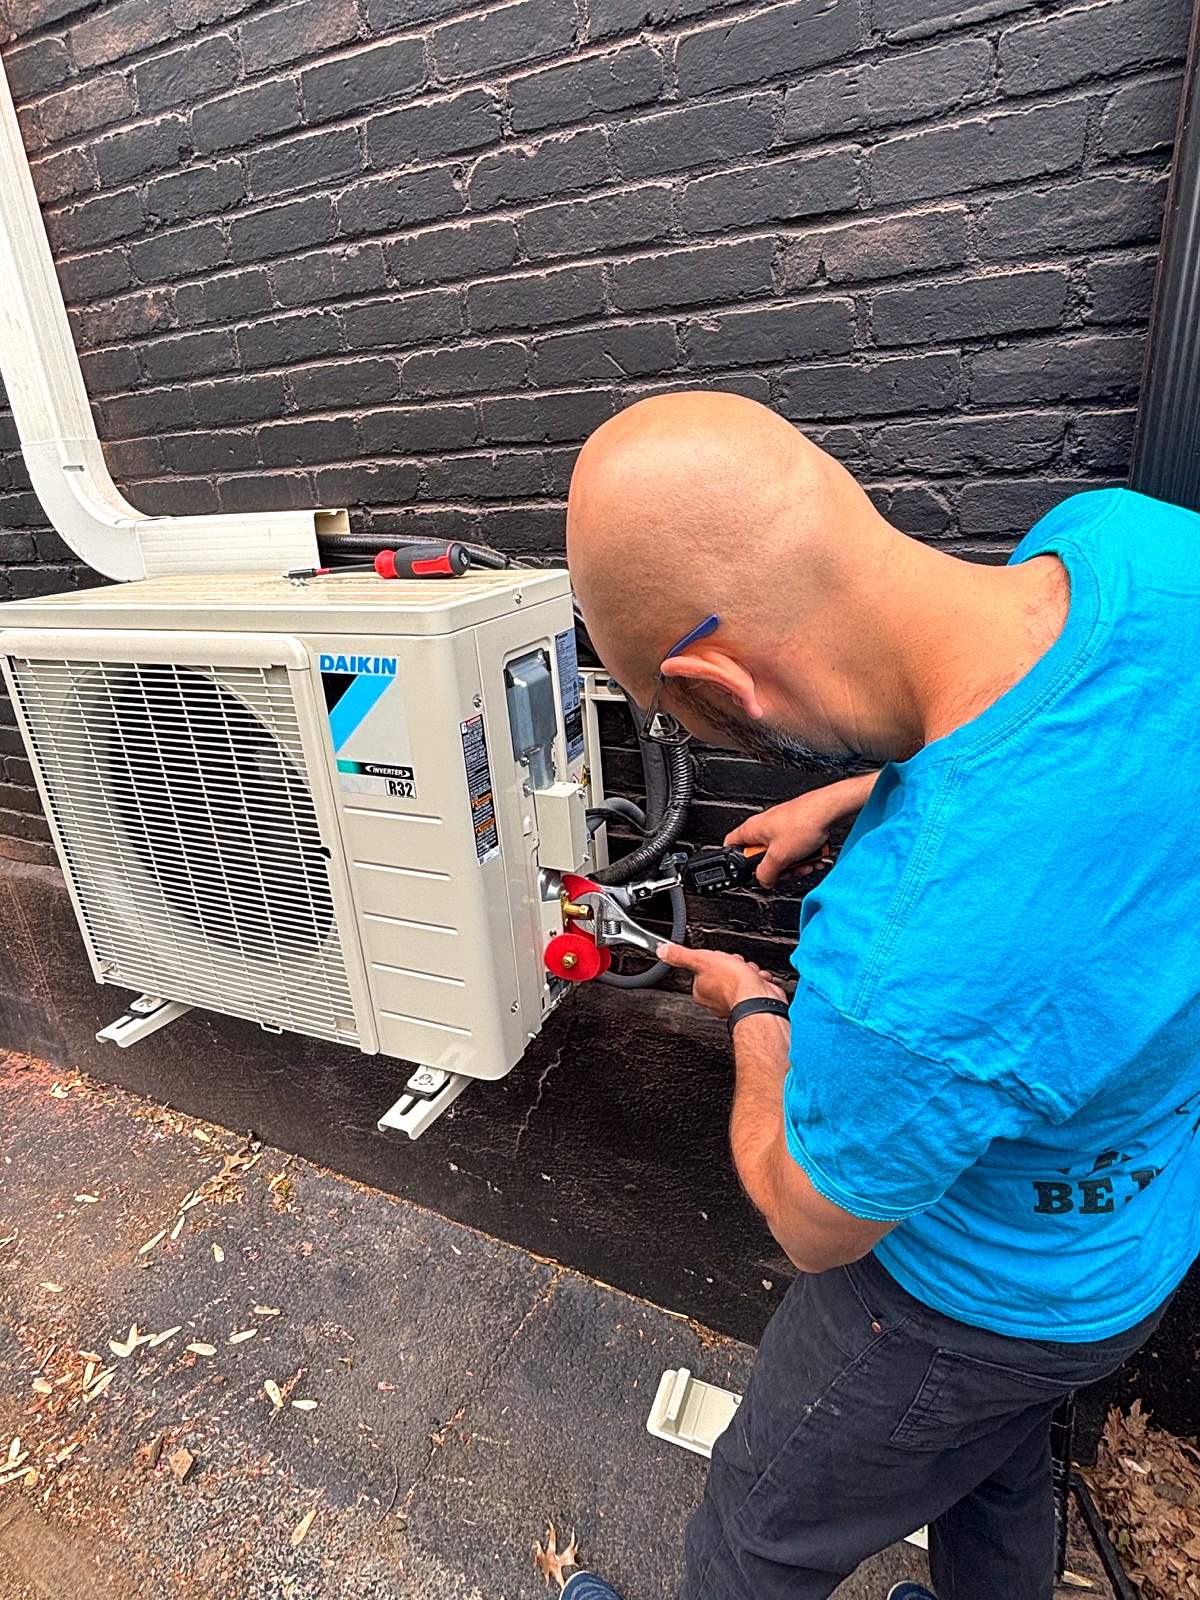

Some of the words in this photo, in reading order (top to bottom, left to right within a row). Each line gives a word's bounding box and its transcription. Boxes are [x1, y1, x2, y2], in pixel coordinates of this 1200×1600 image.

[319, 654, 397, 675] DAIKIN
[372, 766, 403, 776] INVERTER
[388, 780, 414, 798] R32
